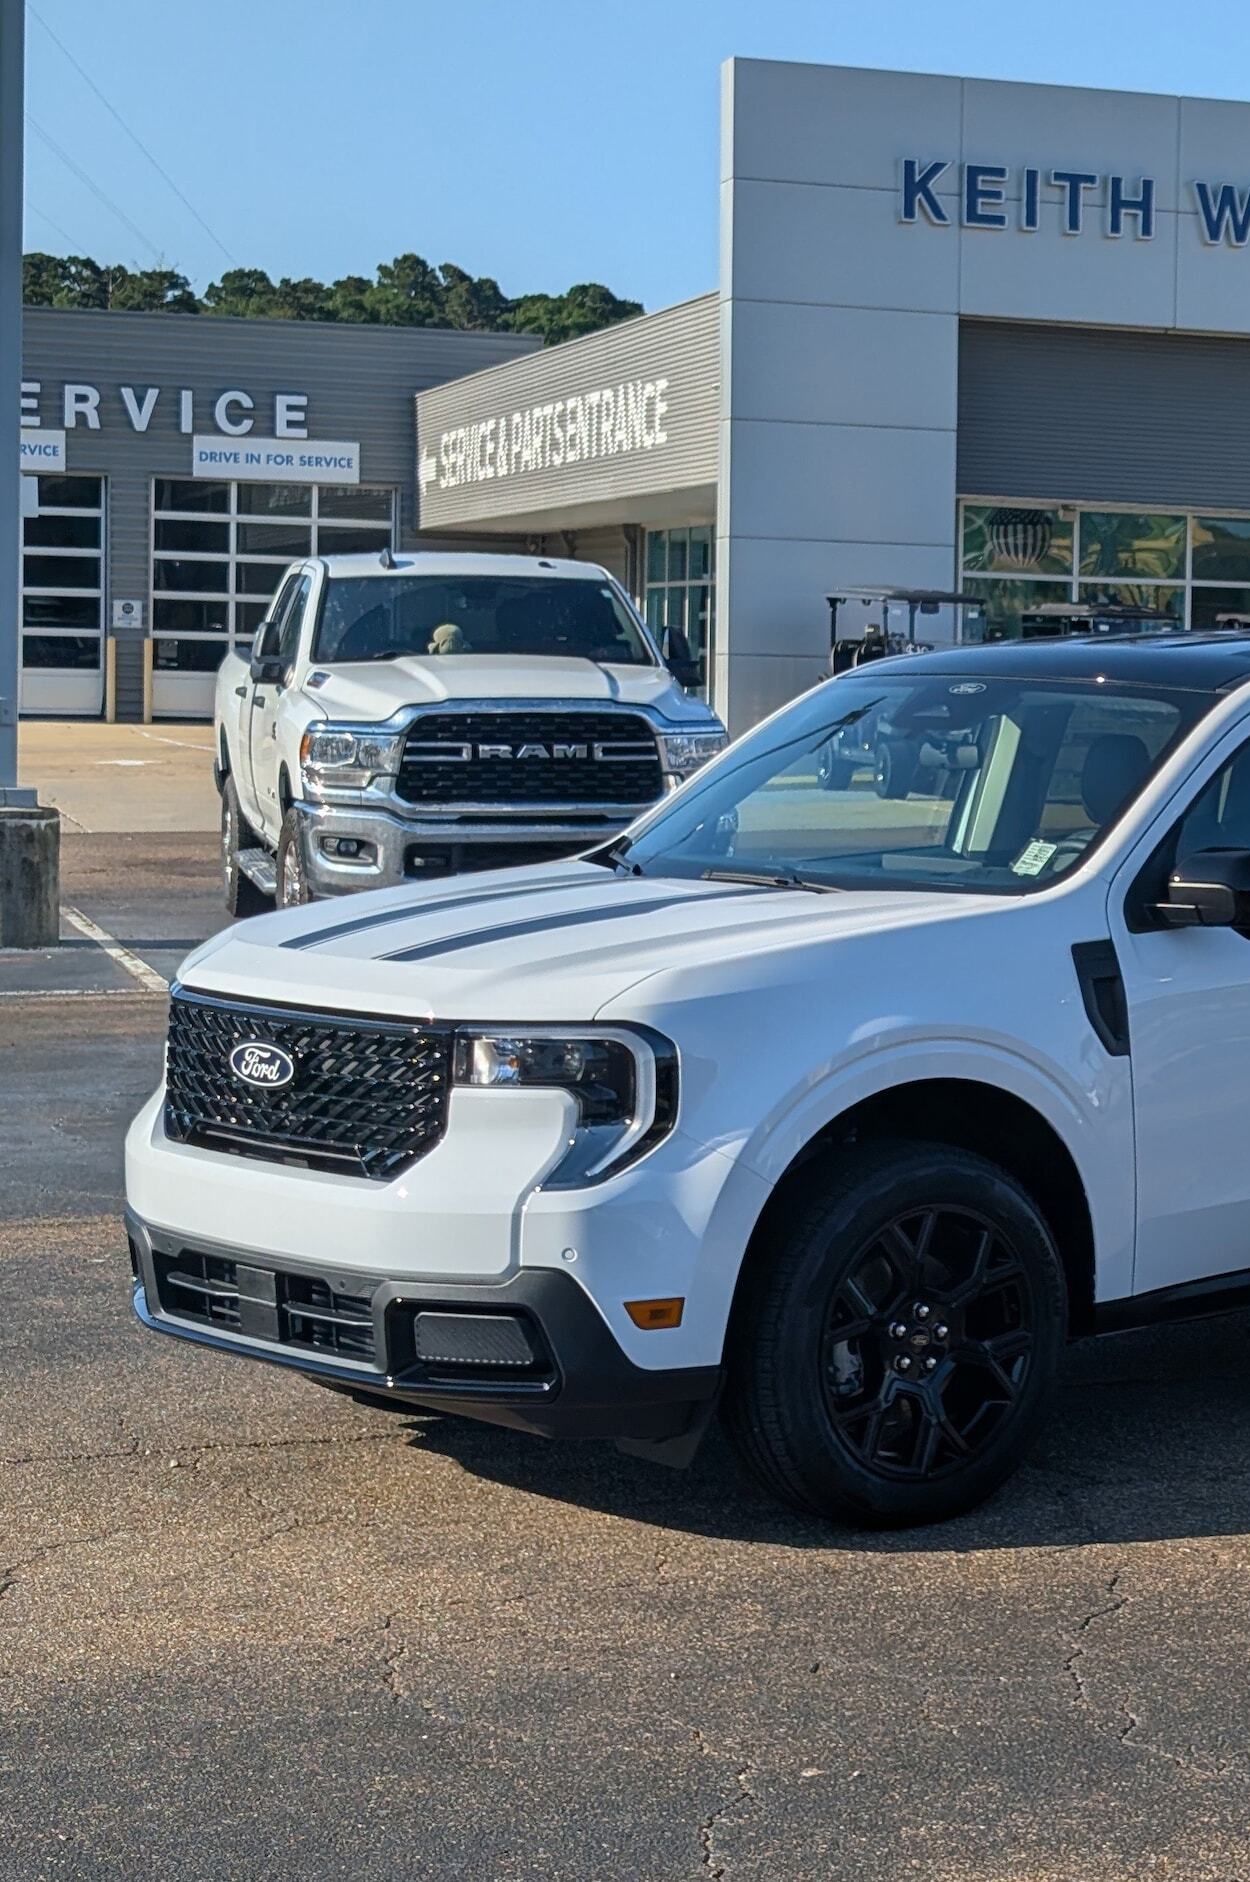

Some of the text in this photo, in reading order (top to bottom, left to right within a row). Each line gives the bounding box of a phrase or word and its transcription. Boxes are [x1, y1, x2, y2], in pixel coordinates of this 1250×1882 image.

[901, 158, 1156, 240] KEITH
[440, 379, 668, 488] SERVICE & PARTS ENTRANCE
[199, 451, 354, 469] DRIVE IN FOR SERVICE
[478, 744, 588, 759] RAM
[241, 1047, 281, 1081] Ford
